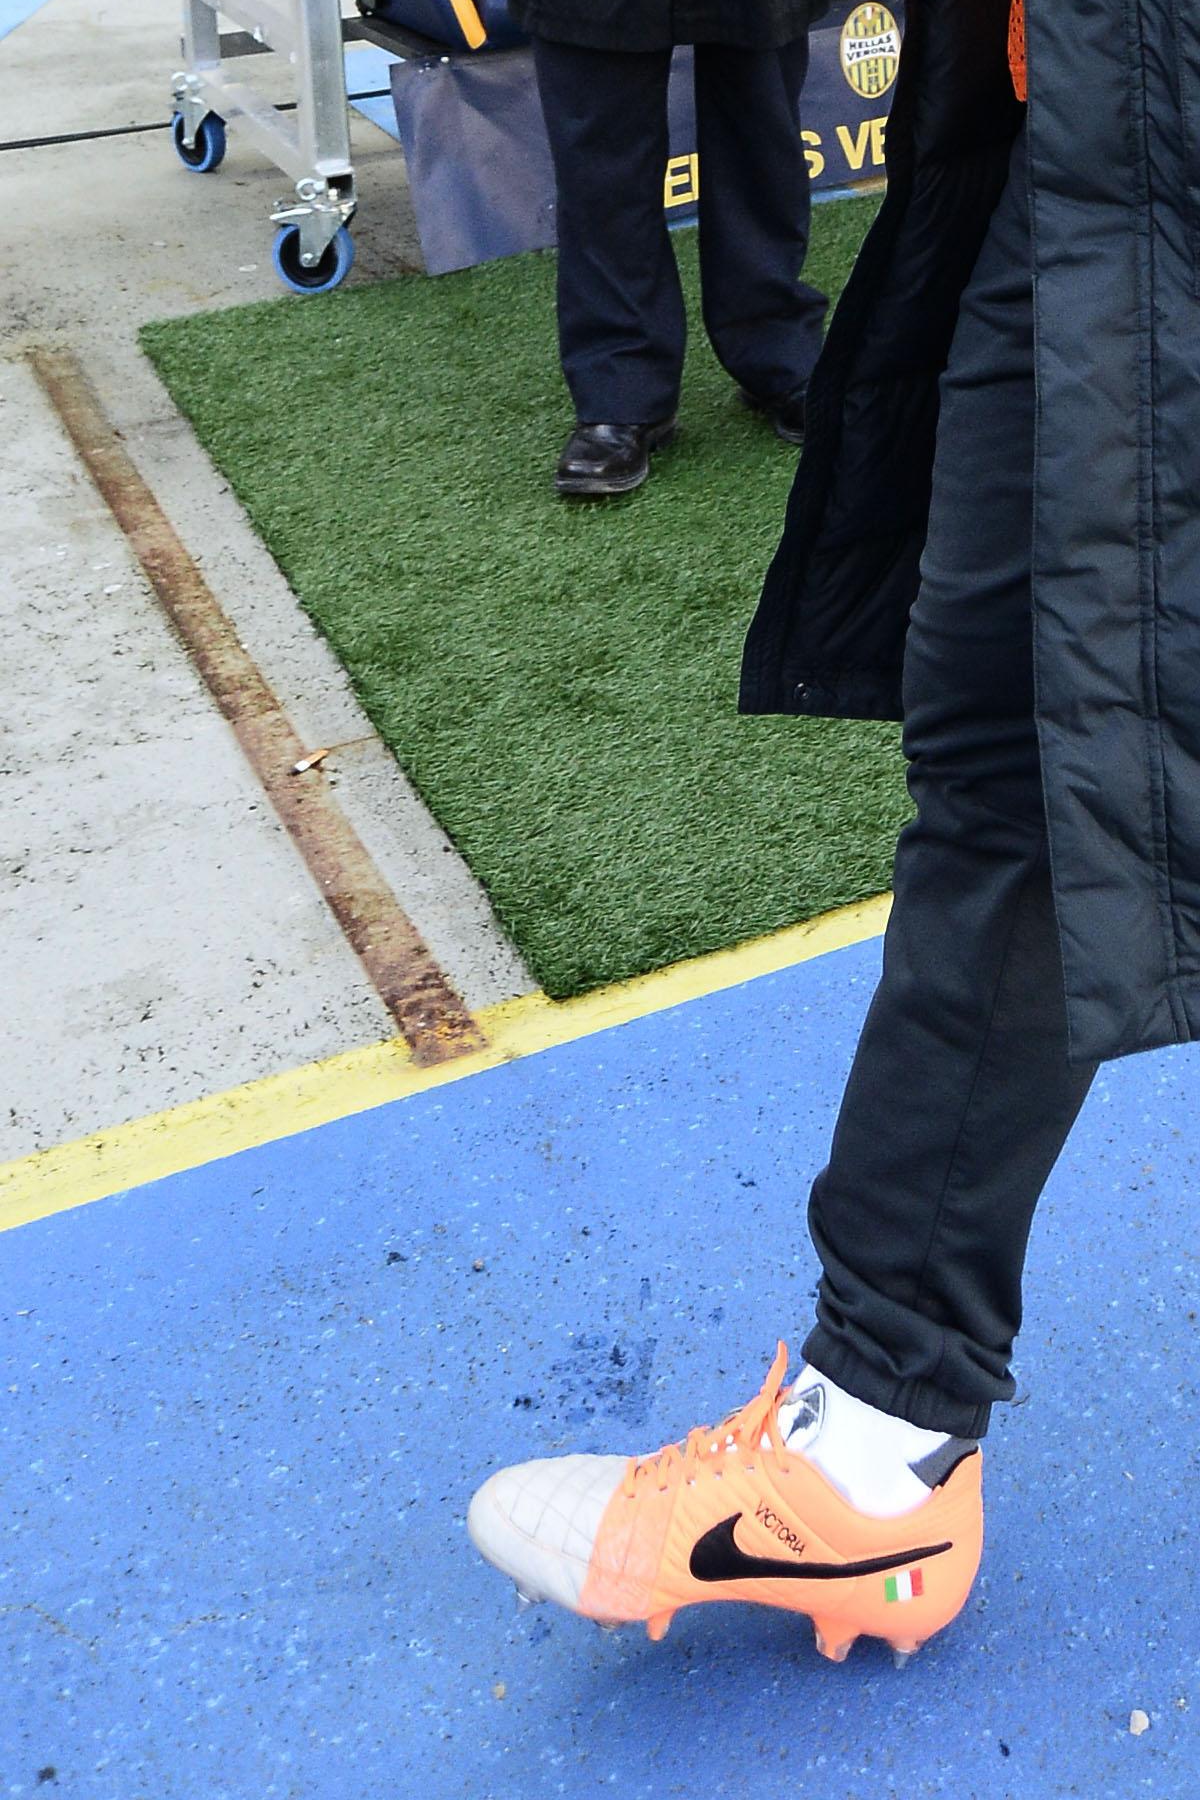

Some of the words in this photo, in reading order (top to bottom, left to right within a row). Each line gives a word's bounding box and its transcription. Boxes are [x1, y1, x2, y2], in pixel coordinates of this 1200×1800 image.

[849, 34, 893, 50] HELLAS
[847, 45, 896, 61] VERONA
[755, 1499, 806, 1557] VICTORIA
